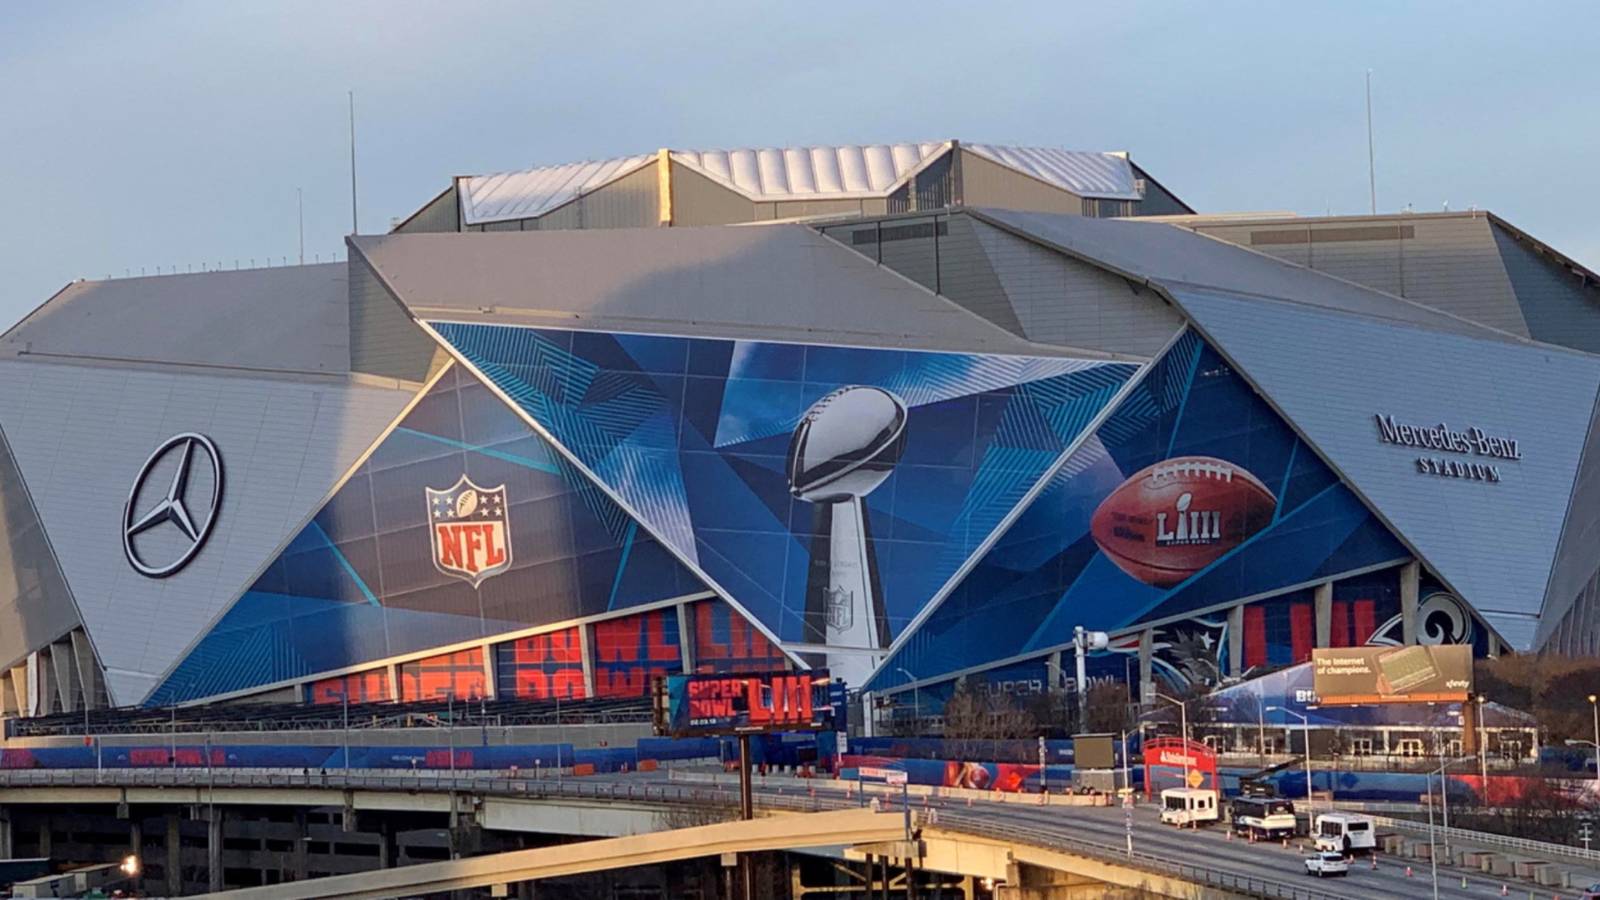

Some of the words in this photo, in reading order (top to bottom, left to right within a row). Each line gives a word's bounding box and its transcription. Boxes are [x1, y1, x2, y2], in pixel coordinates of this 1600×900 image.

[1375, 413, 1522, 460] Mercedes-Benz
[1414, 456, 1501, 482] STADIUM
[438, 524, 504, 572] NFL
[1317, 658, 1331, 666] The
[1333, 657, 1365, 666] Internet
[1317, 667, 1325, 675] of
[688, 679, 741, 698] SUPER
[748, 675, 813, 722] LIII
